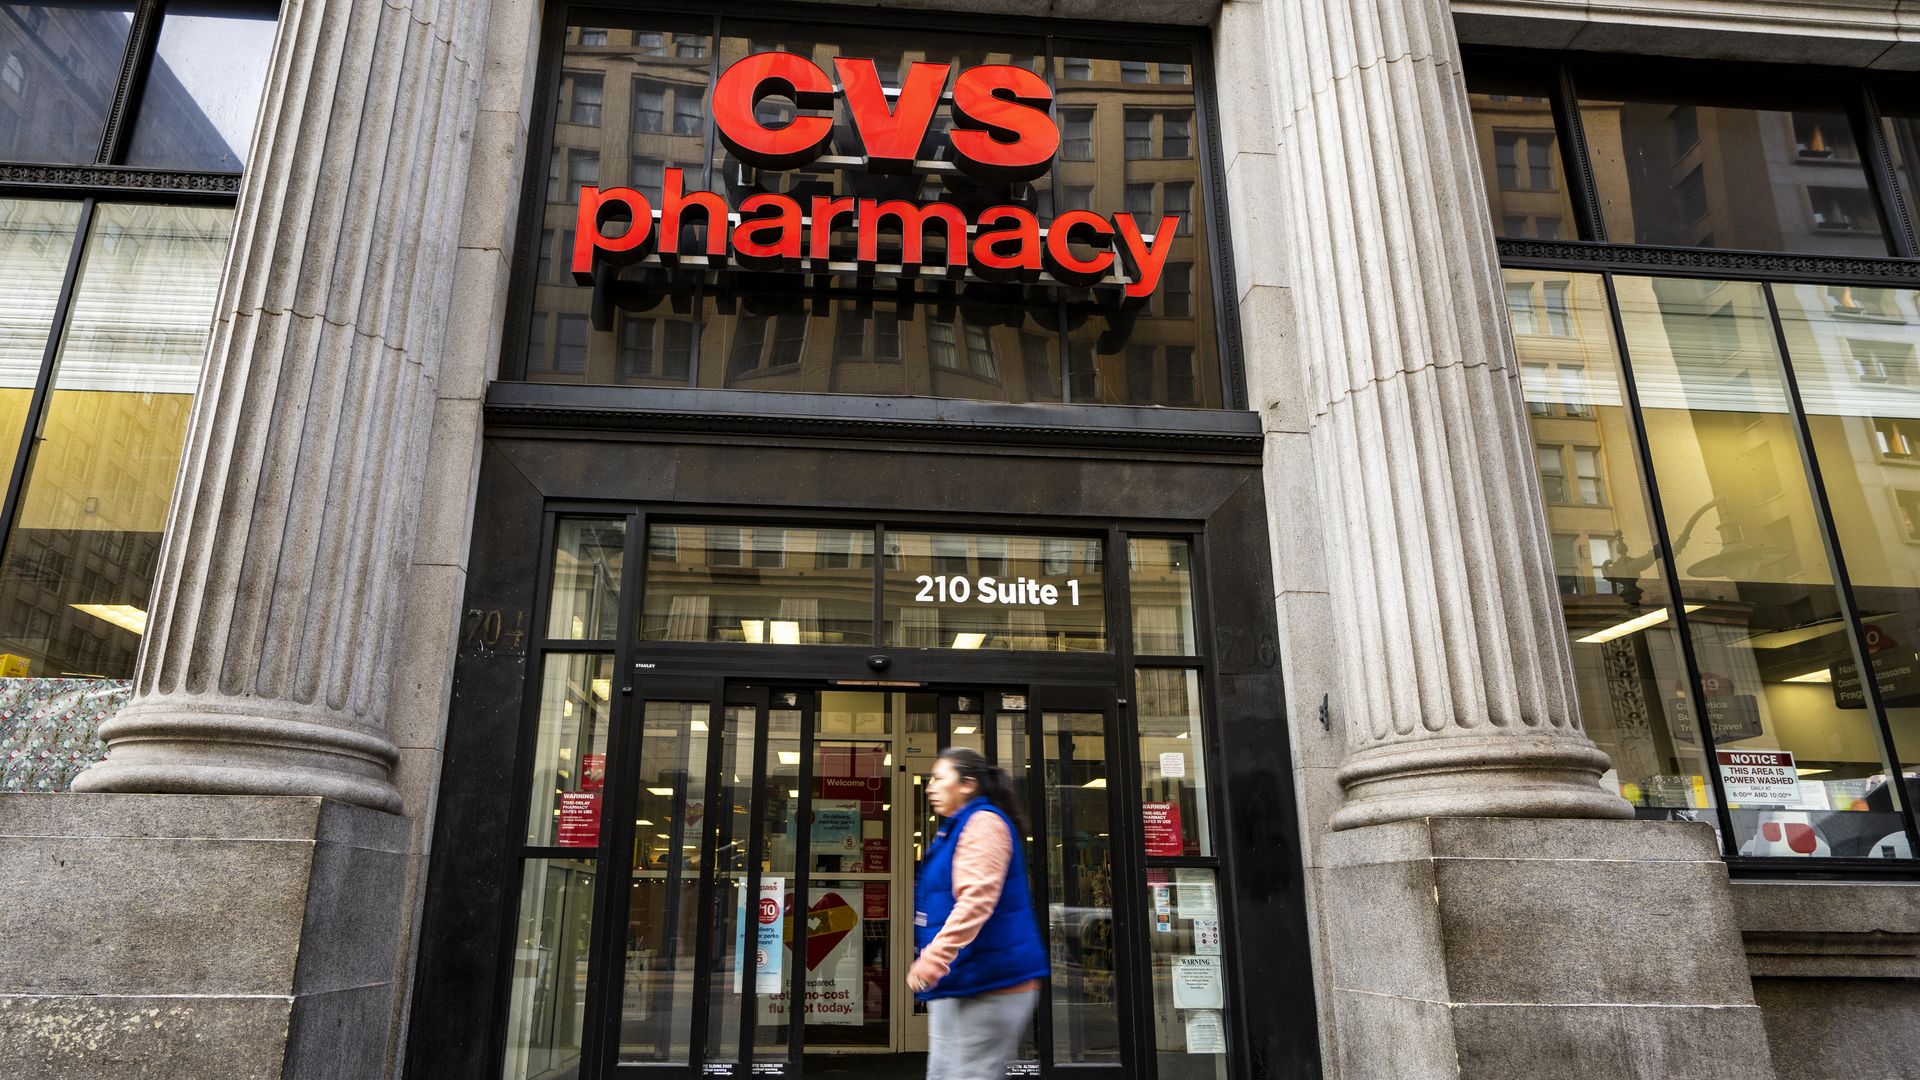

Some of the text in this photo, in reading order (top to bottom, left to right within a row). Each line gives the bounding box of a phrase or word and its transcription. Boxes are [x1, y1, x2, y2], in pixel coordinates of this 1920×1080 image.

[711, 51, 1061, 173] CVS
[572, 167, 1181, 299] pharmacy
[915, 575, 1080, 606] 210 Suite 1
[1730, 754, 1778, 765] NOTICE
[1729, 767, 1784, 776] THIS AREA IS
[826, 778, 865, 787] Welcome
[1723, 776, 1794, 785] POWER WASHED
[805, 979, 836, 988] repared.
[805, 989, 850, 1000] no-cost
[769, 1003, 785, 1014] flu
